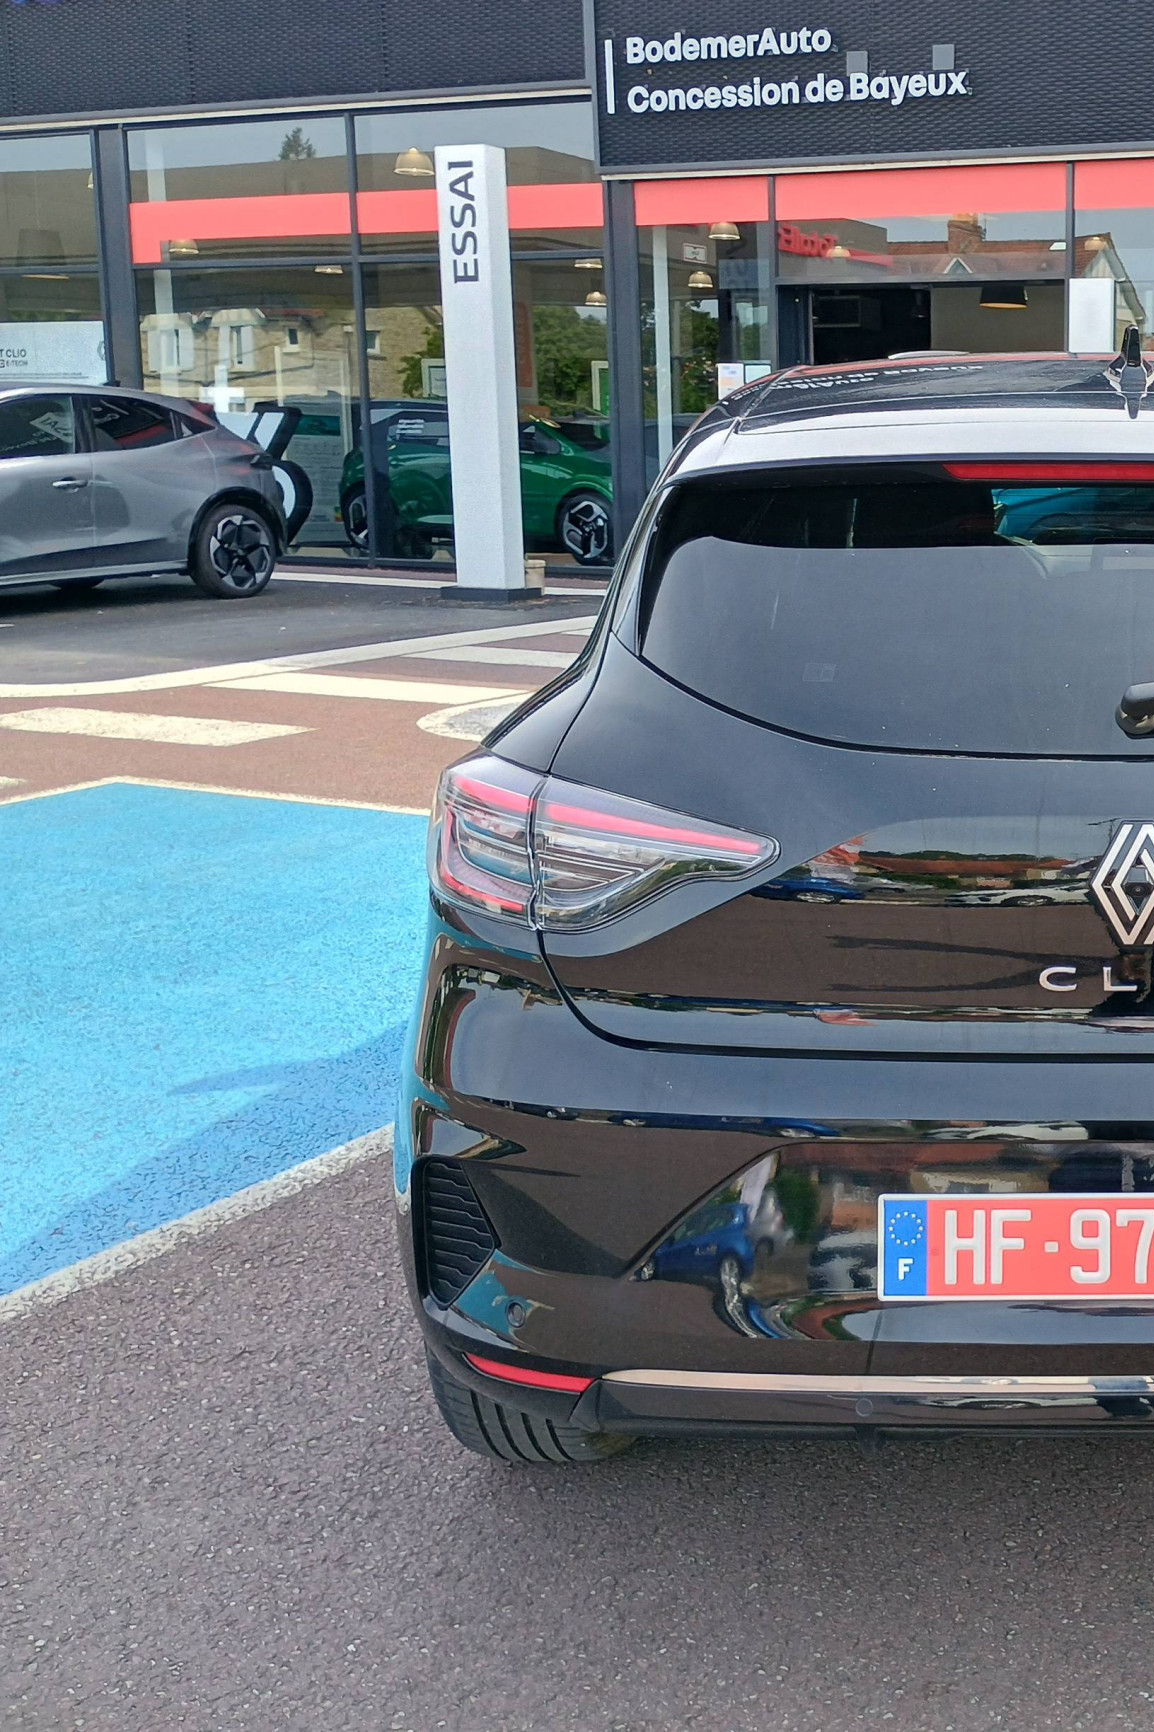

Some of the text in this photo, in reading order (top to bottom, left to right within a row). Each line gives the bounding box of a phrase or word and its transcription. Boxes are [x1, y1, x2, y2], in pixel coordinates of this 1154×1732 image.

[626, 26, 832, 64] BodemerAuto
[627, 71, 968, 114] Concession de Bayeux
[447, 160, 480, 284] ESSAI
[5, 348, 27, 358] CLIO
[897, 1257, 914, 1281] F
